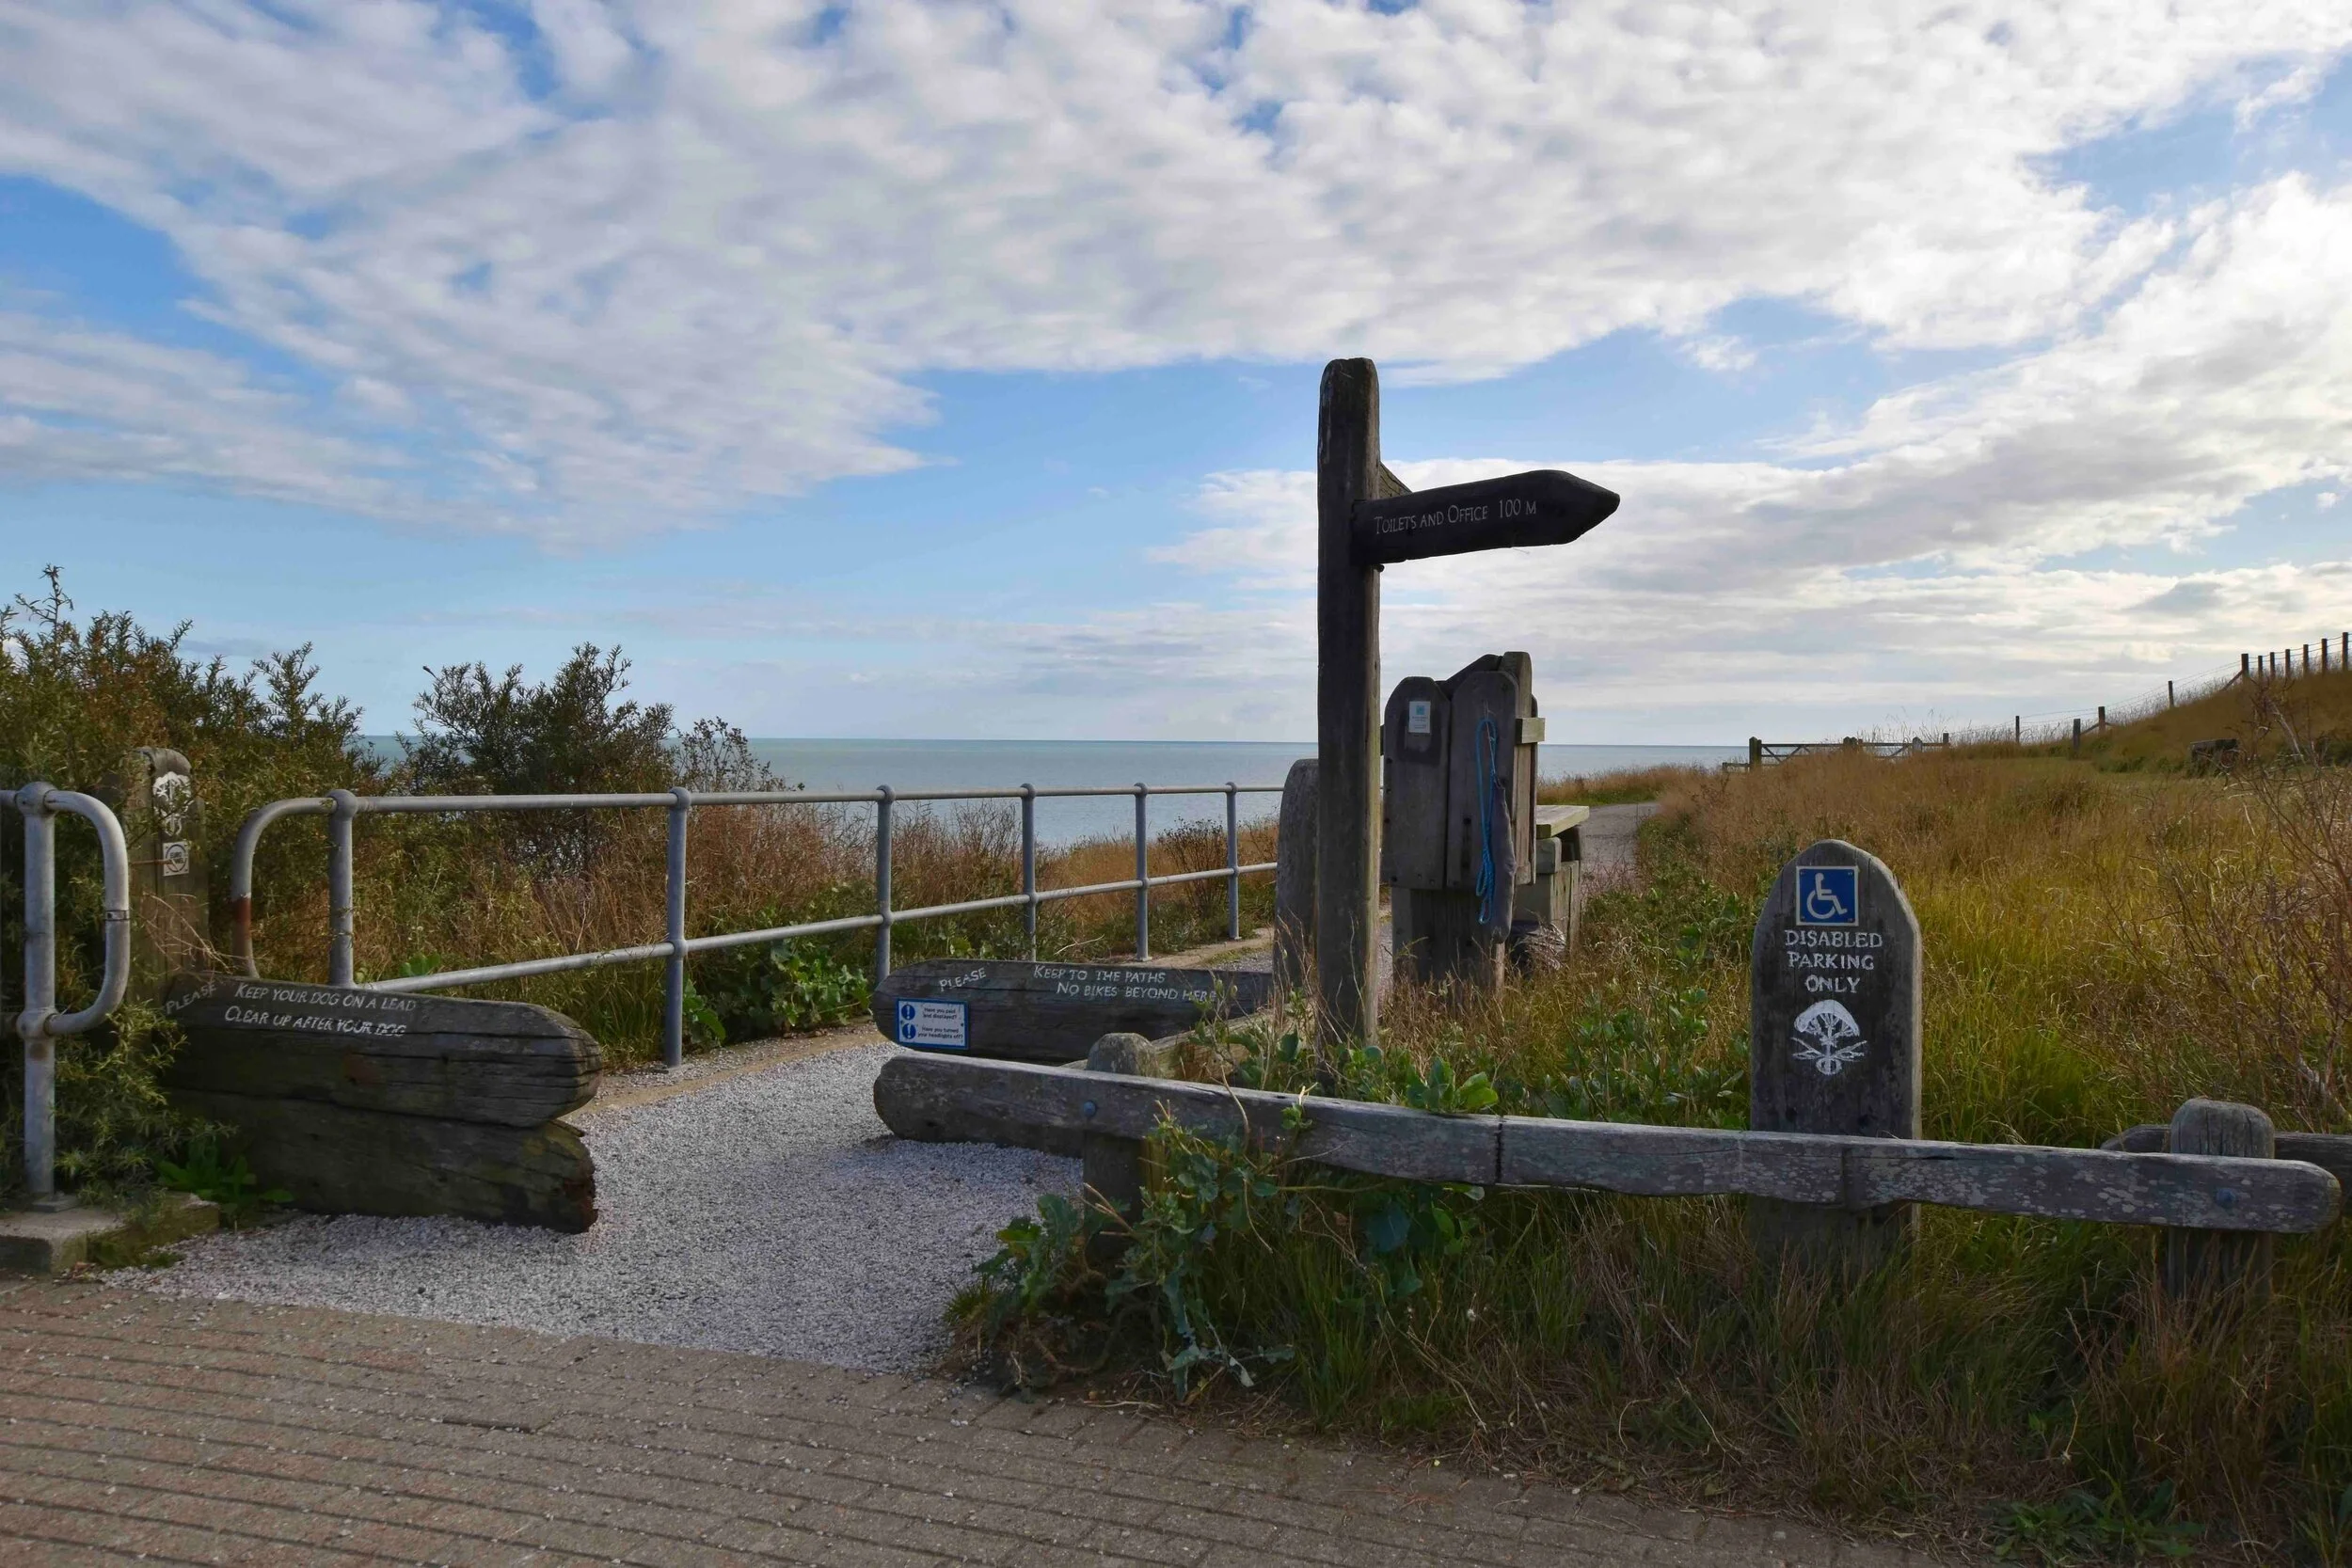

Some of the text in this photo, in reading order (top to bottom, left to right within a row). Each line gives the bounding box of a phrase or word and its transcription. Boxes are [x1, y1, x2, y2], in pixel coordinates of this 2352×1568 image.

[1374, 498, 1537, 534] TOILETS AND OFFICE 100 M
[1785, 929, 1883, 948] DISABLED
[1788, 950, 1875, 971] PARKING
[940, 967, 987, 992] PLEASE
[1033, 964, 1167, 984] KEEP TO THE PATHS
[1805, 974, 1861, 993] ONLY
[166, 984, 217, 1015] PLEASE
[235, 983, 416, 1012] KEEP YOUR DOG ON A LEAD
[1056, 981, 1080, 997] NO
[1084, 985, 1118, 998] BIKES
[1125, 987, 1179, 1001] BEYOND
[225, 1006, 406, 1037] CLEAR UP AFTER YOUR DOG
